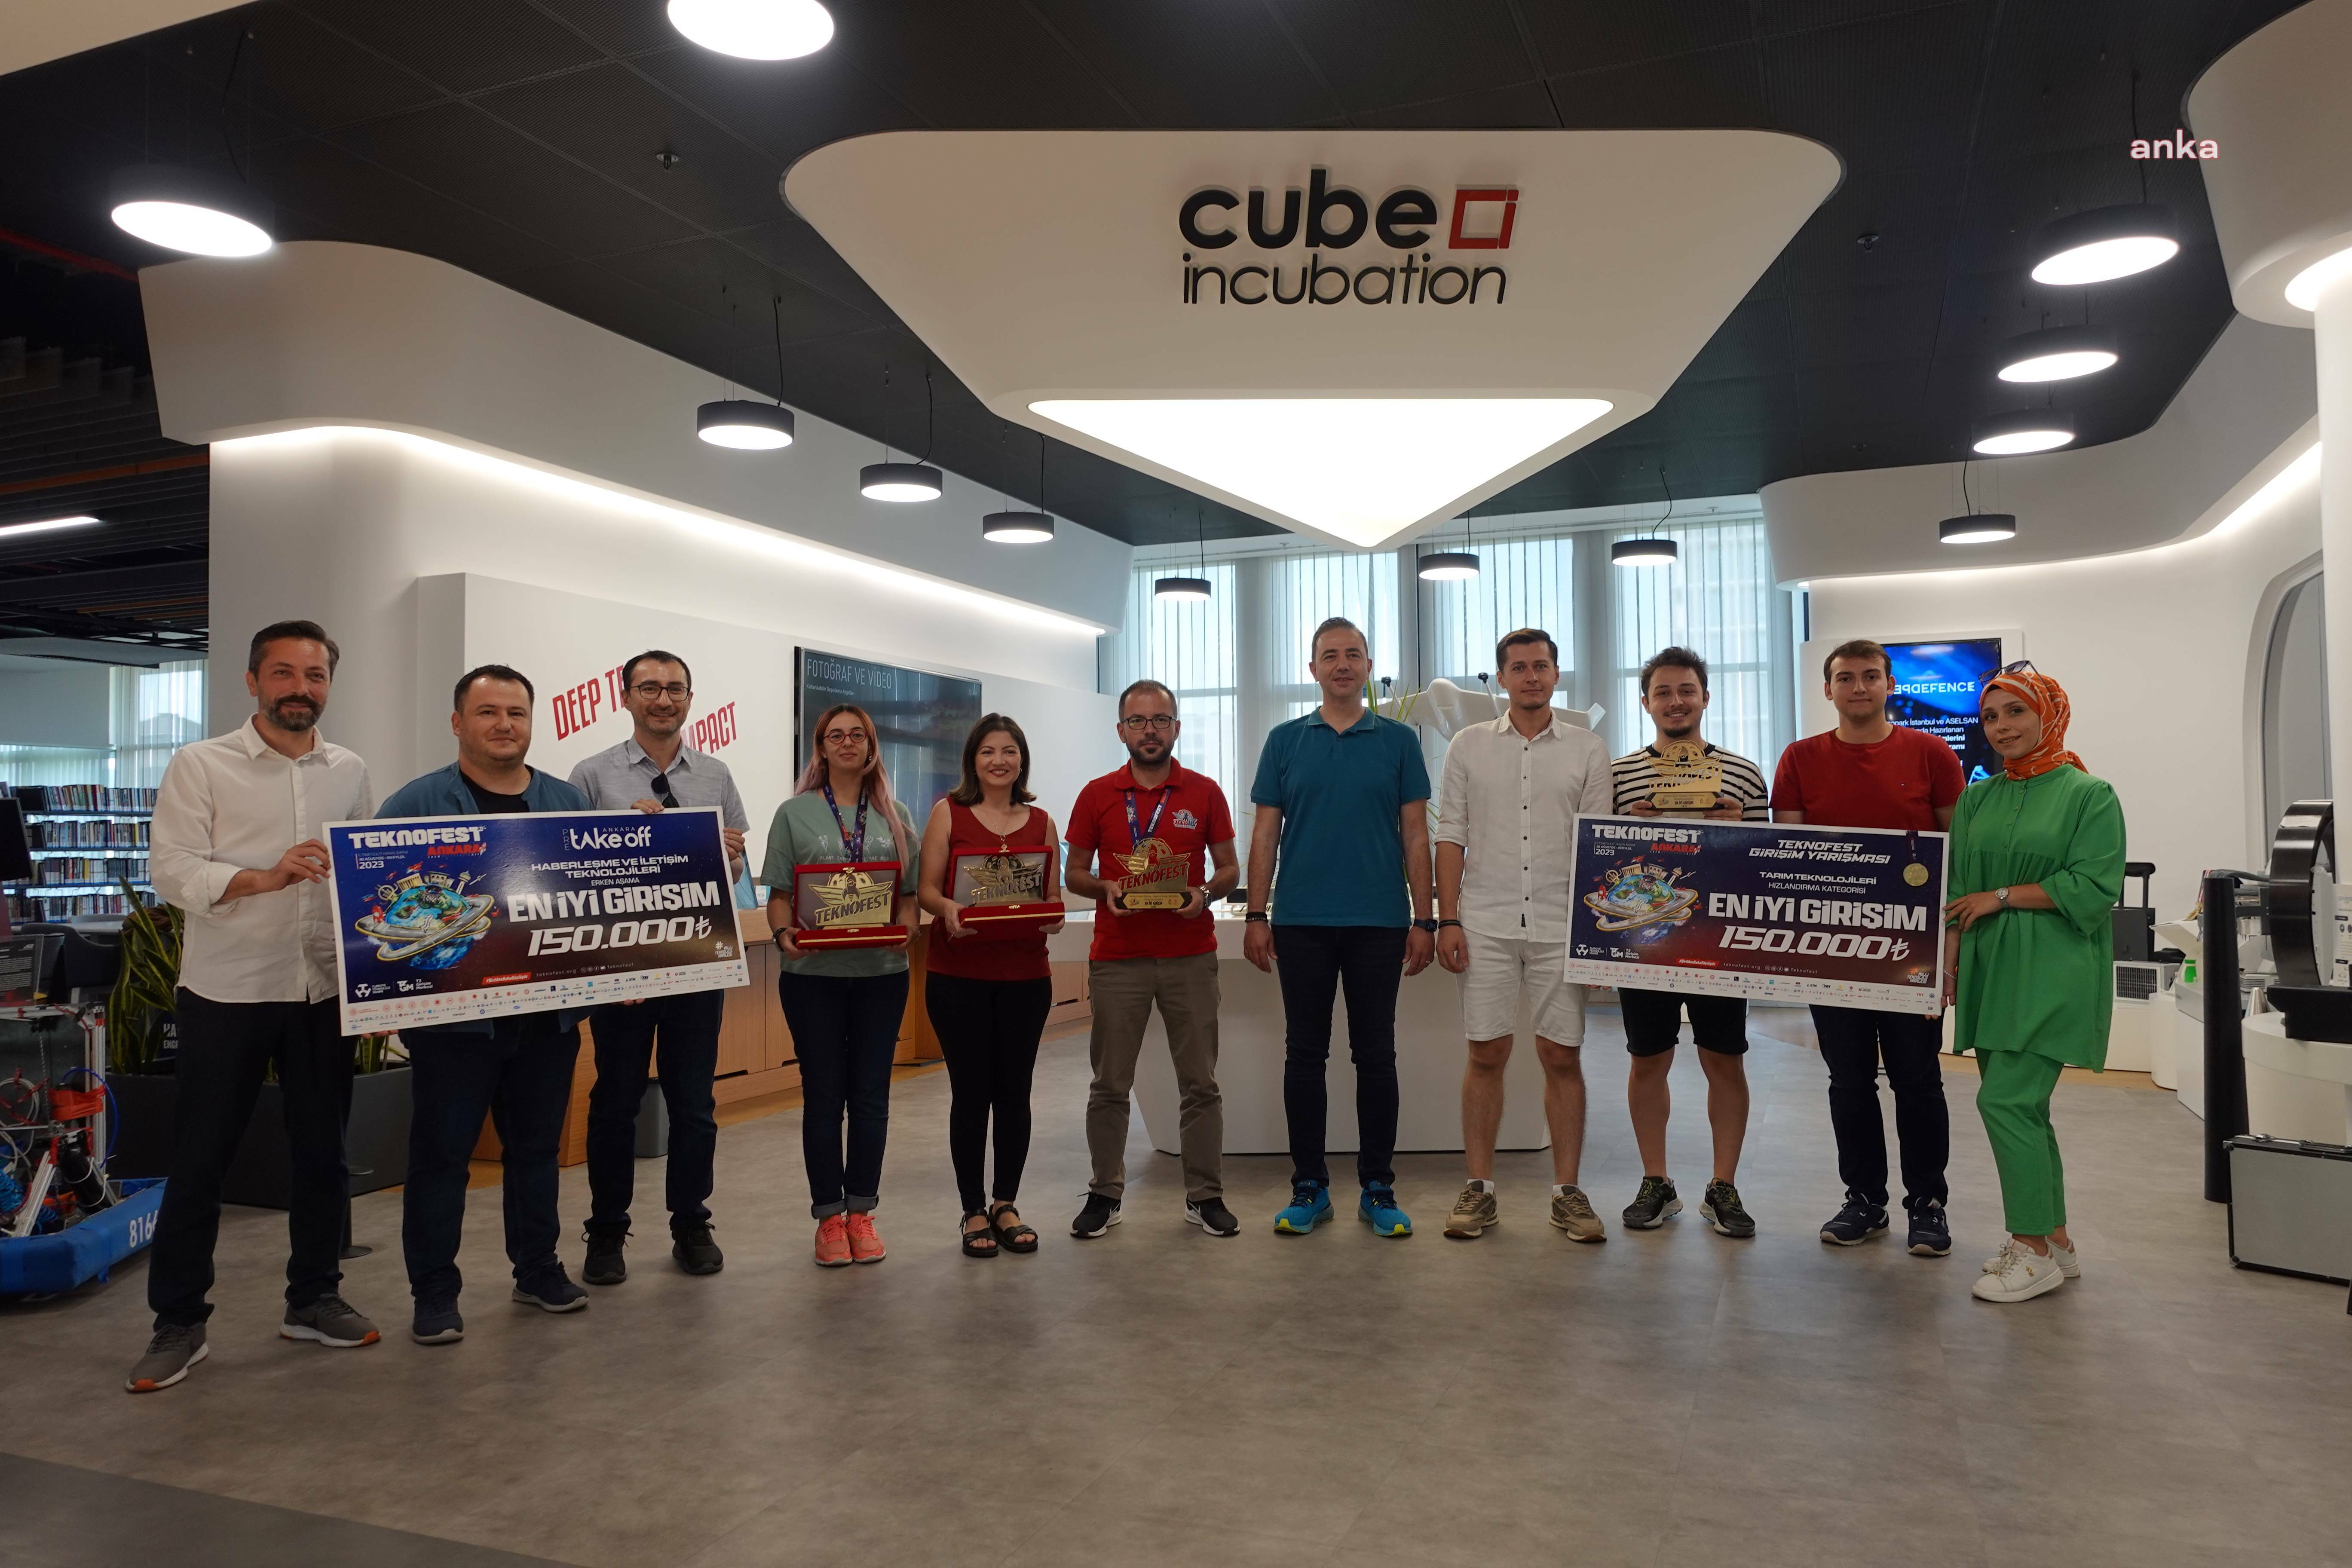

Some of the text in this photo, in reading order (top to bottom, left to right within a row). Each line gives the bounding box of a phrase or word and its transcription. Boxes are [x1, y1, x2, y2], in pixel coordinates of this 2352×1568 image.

[1179, 168, 1437, 249] cube
[1182, 252, 1507, 305] incubation
[807, 658, 891, 689] FOTOĞRAF VE VİDEO
[552, 665, 625, 741] DEEP TE
[682, 701, 737, 754] MPACT
[1649, 765, 1721, 792] TEKNOFEST
[348, 826, 485, 849] TEKNOFEST
[1592, 824, 1701, 843] TEKNOFEST
[427, 843, 482, 856] ANKARA
[1651, 843, 1697, 853] ANKARA
[1777, 839, 1864, 852] TEKNOFEST
[531, 854, 689, 872] HABERLEŞME VE İLETİŞİM
[1749, 847, 1891, 864] GİRİŞİM YARIŞMASI
[359, 861, 384, 870] 2023
[565, 864, 661, 879] TEKNOLOJİLERİ
[615, 877, 640, 886] AŞAMA
[1120, 864, 1188, 891] TEKNOFEST
[1759, 871, 1877, 885] TARIM TEKNOLOJİLERİ
[971, 873, 1042, 904] TEKNOFEST
[1768, 882, 1866, 894] HIZLANDIRMA KATEGORİSİ
[507, 881, 721, 923] EN İYİ GİRİŞİM
[816, 892, 890, 924] TEKNOFEST
[1708, 892, 1927, 931] EN İYİ GİRİŞİM
[536, 969, 577, 977] teknofest.org
[163, 1023, 177, 1037] HA
[163, 1040, 179, 1049] ENG
